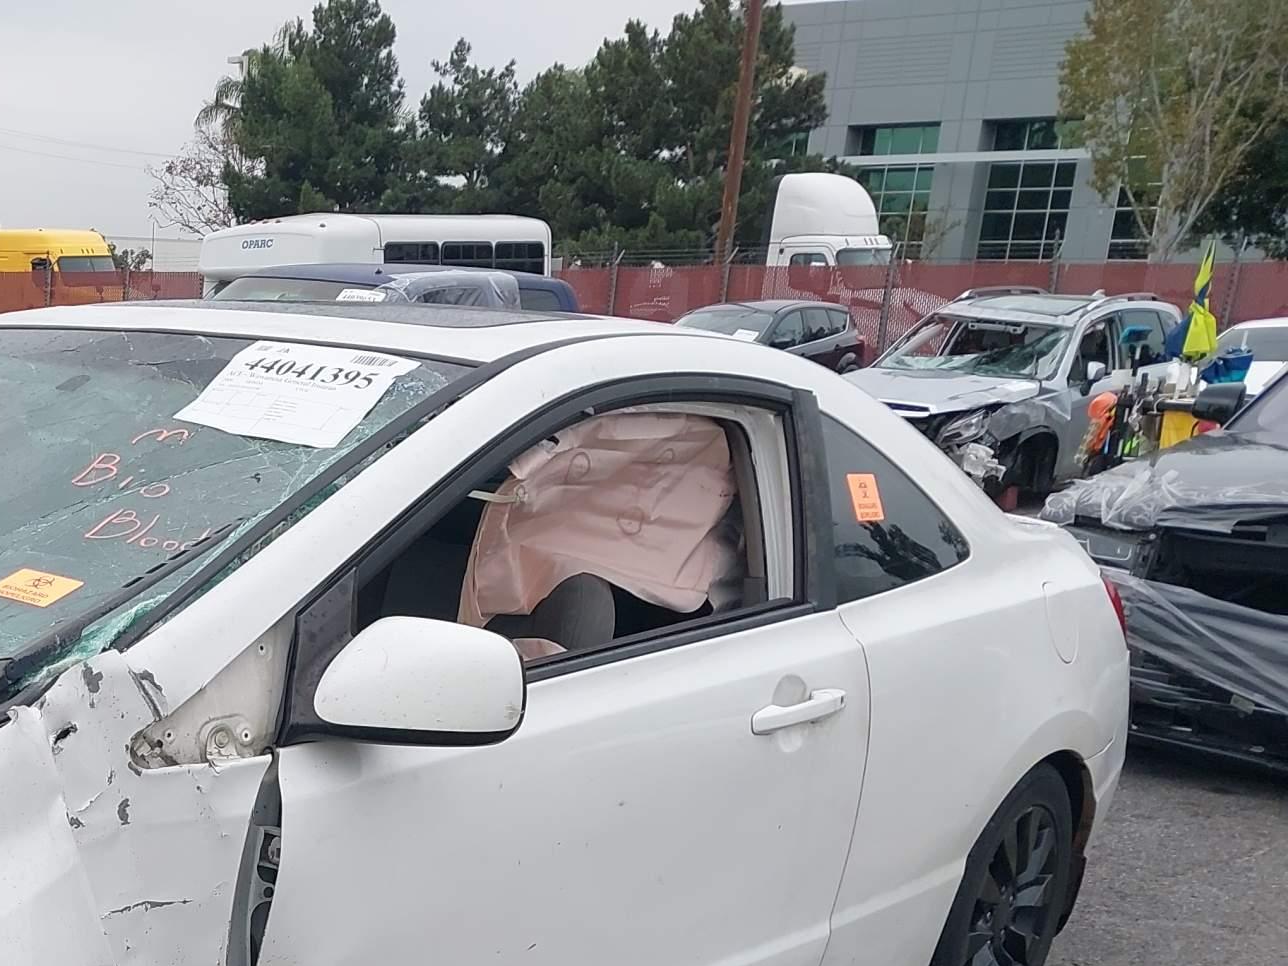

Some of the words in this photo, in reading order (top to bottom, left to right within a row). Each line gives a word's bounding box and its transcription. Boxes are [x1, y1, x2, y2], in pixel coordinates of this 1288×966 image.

[242, 238, 274, 249] OPARC
[245, 357, 379, 390] 44041395
[71, 453, 170, 498] Bio
